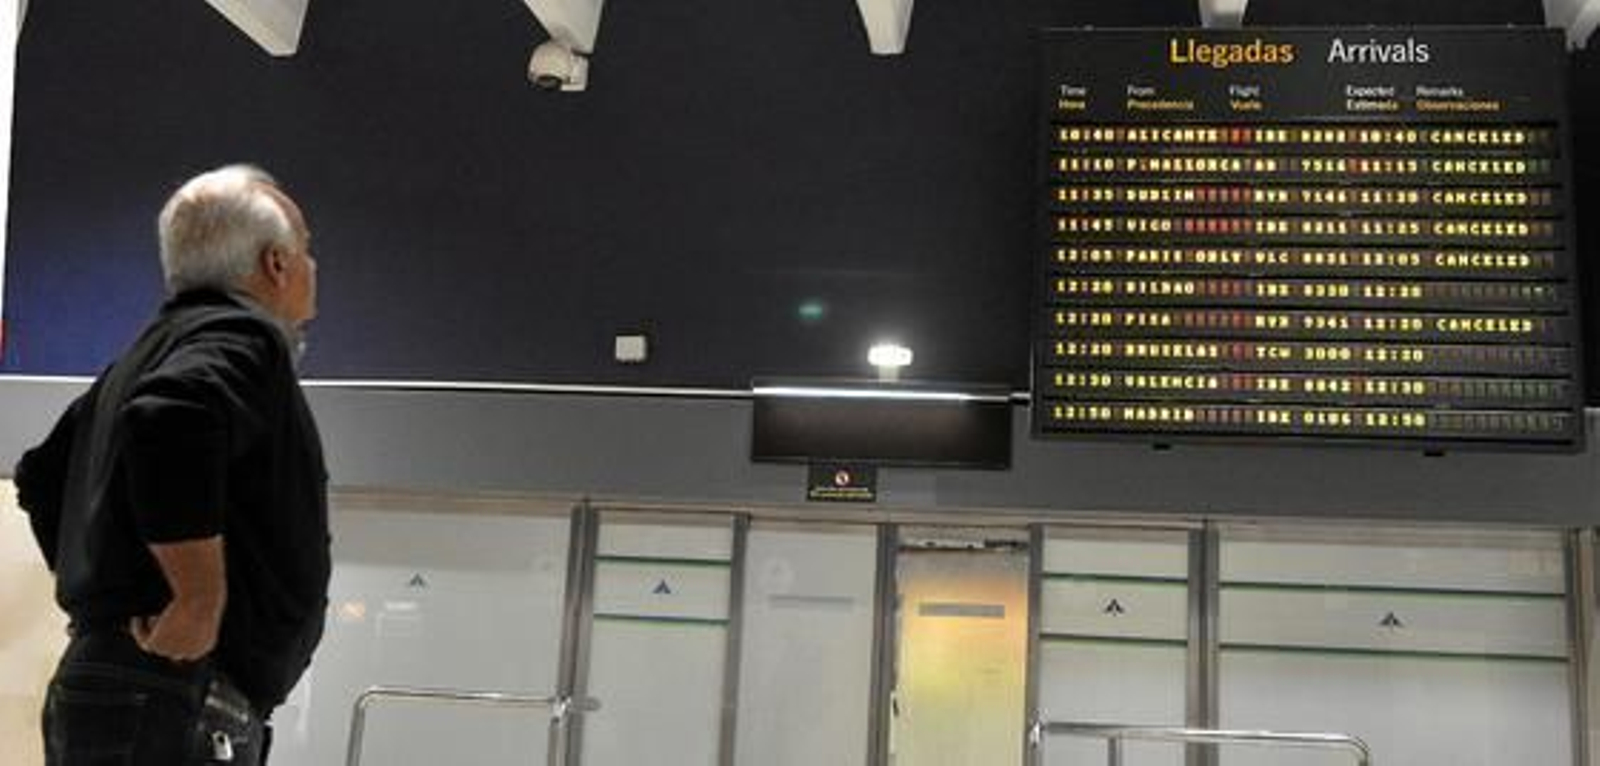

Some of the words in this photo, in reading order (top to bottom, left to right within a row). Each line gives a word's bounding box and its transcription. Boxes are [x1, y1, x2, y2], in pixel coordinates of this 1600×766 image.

[1170, 38, 1295, 68] Llegadas
[1327, 38, 1430, 63] Arrivals
[1127, 129, 1217, 143] ALICANTE
[1360, 130, 1417, 144] 10:40
[1431, 131, 1524, 144] CANCELED
[1432, 161, 1525, 174] CANCELED
[1433, 192, 1526, 205] CANCELED
[1434, 223, 1528, 236] CANCELED
[1435, 253, 1529, 267] CANCELED
[1437, 318, 1532, 333] CANCELED
[1125, 376, 1218, 390] VALENCIA
[1124, 408, 1194, 422] MADRID
